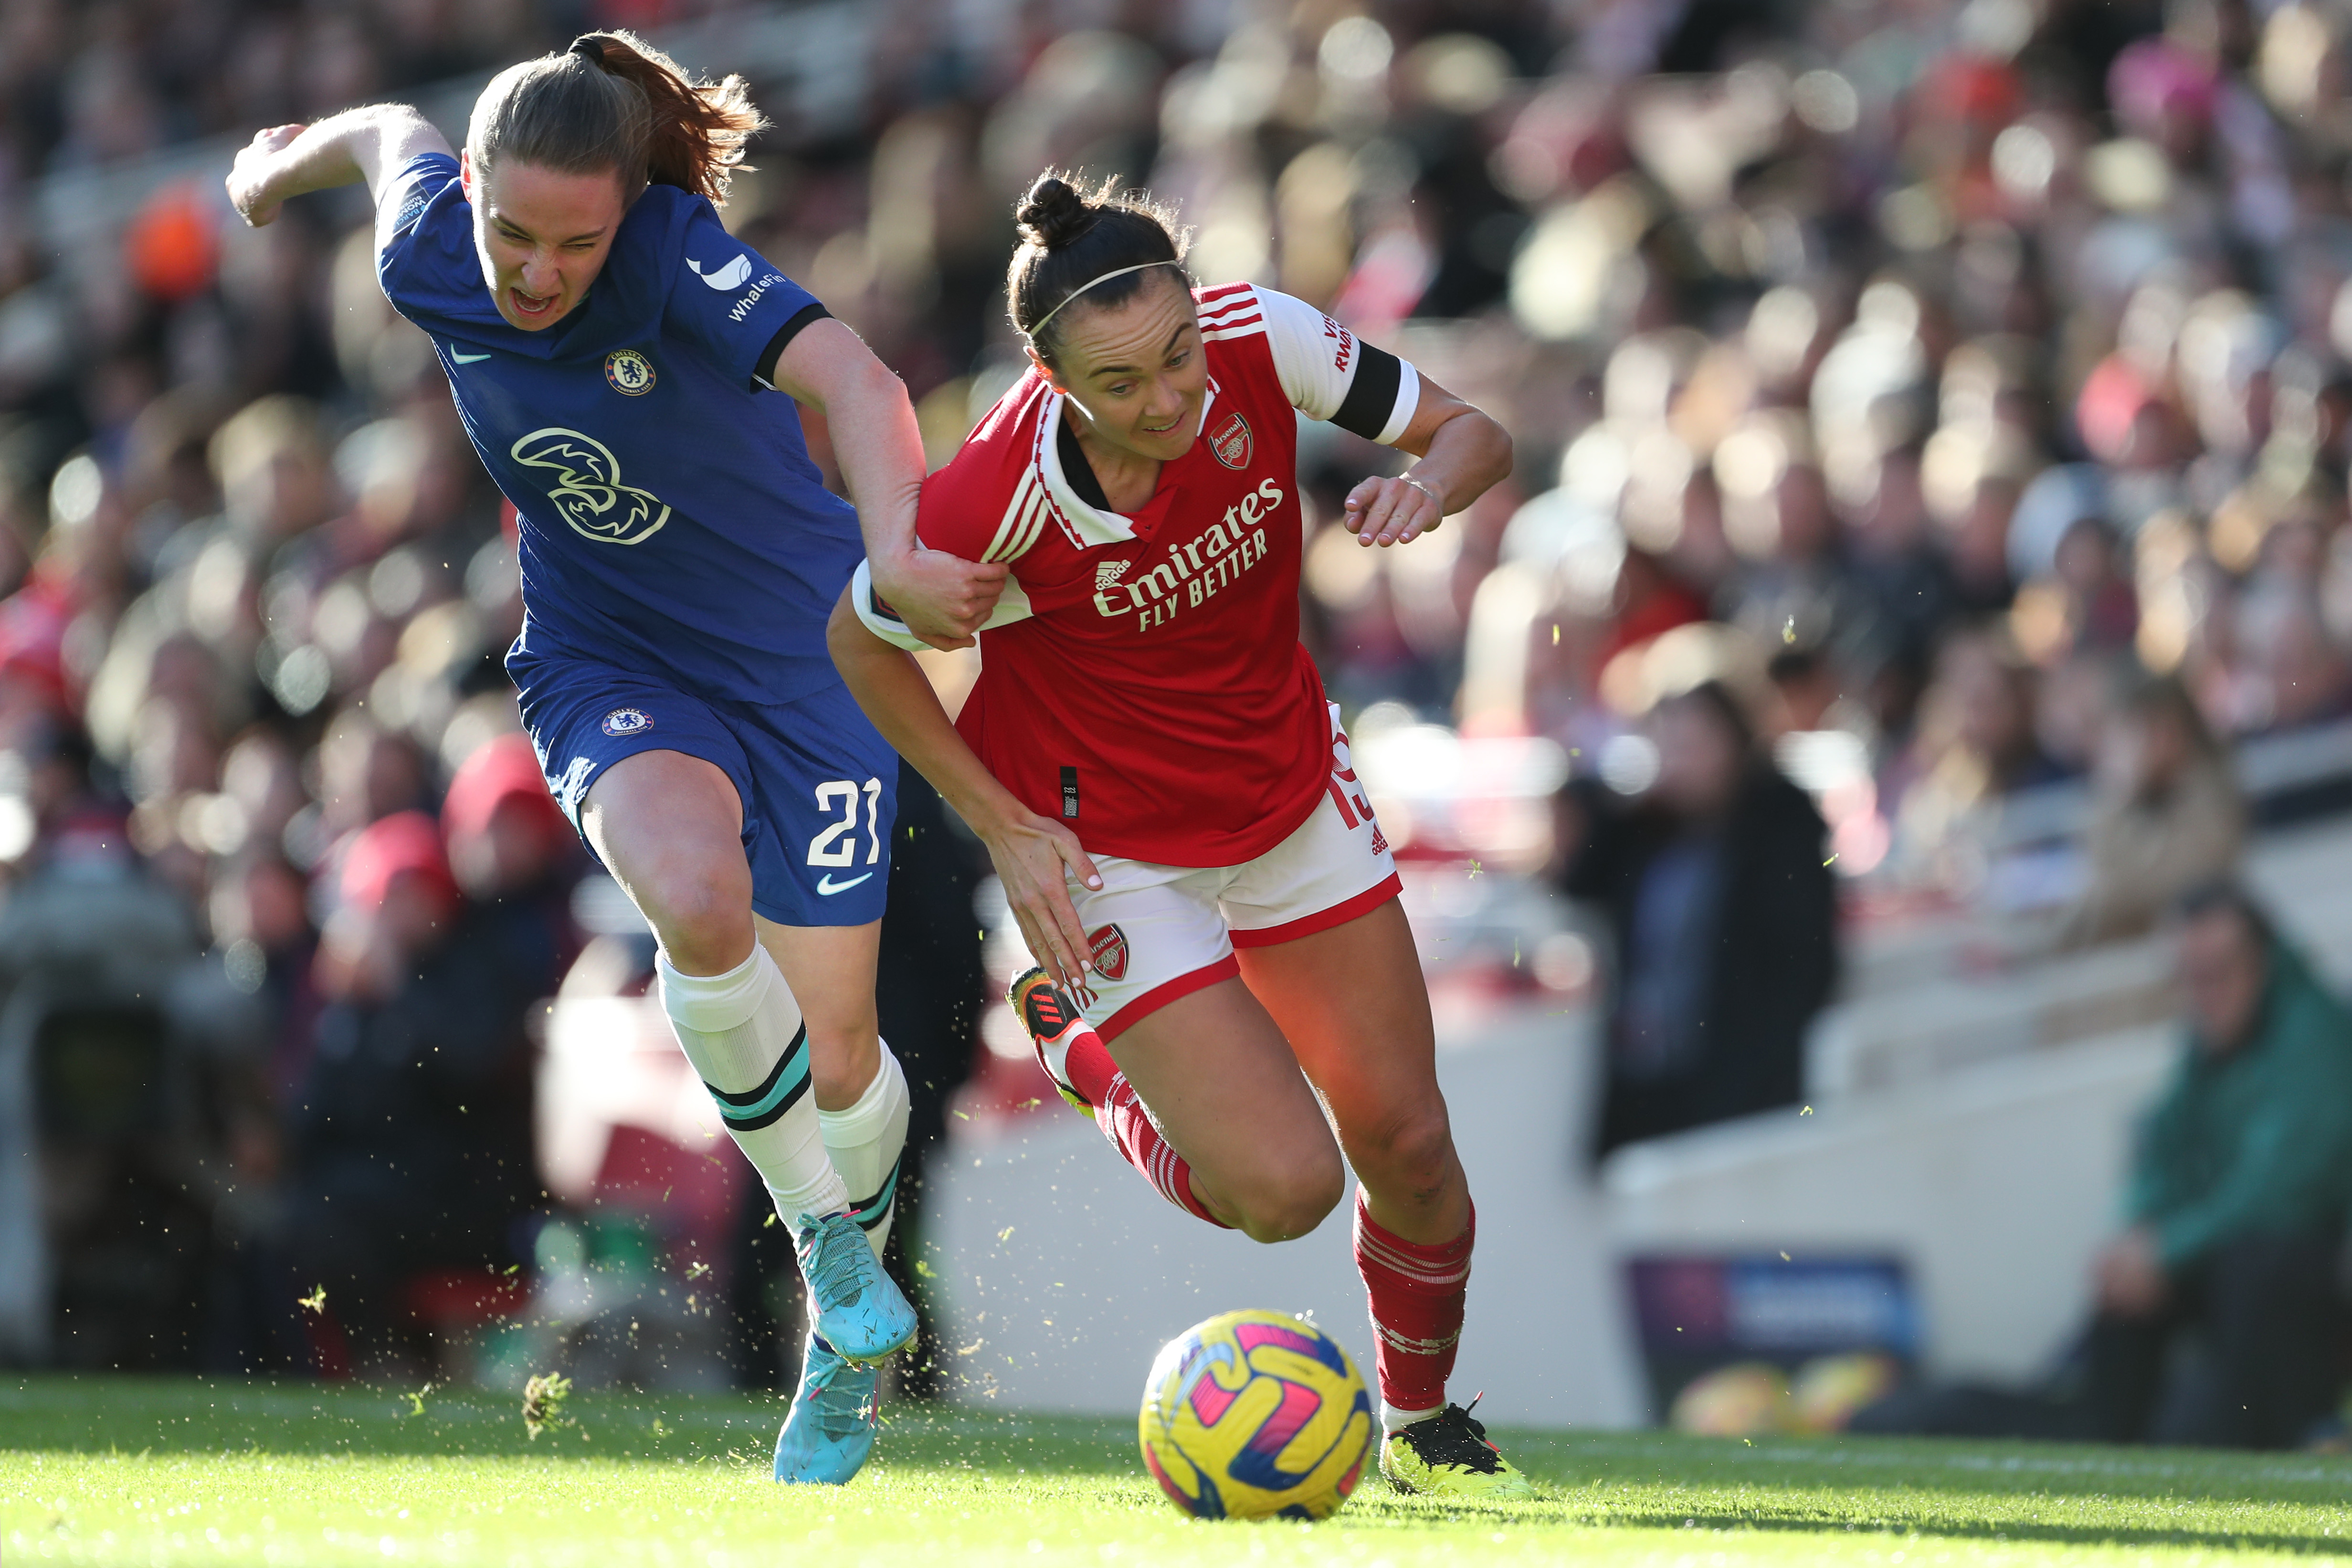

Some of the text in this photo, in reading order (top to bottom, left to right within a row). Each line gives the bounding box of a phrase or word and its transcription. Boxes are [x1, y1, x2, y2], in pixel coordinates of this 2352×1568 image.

[397, 200, 426, 219] WOM
[728, 274, 786, 322] WhaleFin
[611, 351, 642, 361] CHELSEA
[1214, 420, 1242, 447] Arsenal
[1093, 477, 1284, 618] Emirates
[1095, 559, 1131, 591] adidas
[1139, 528, 1268, 632] FLY BETTER
[607, 708, 640, 719] CHELSEA
[807, 777, 882, 867] 21
